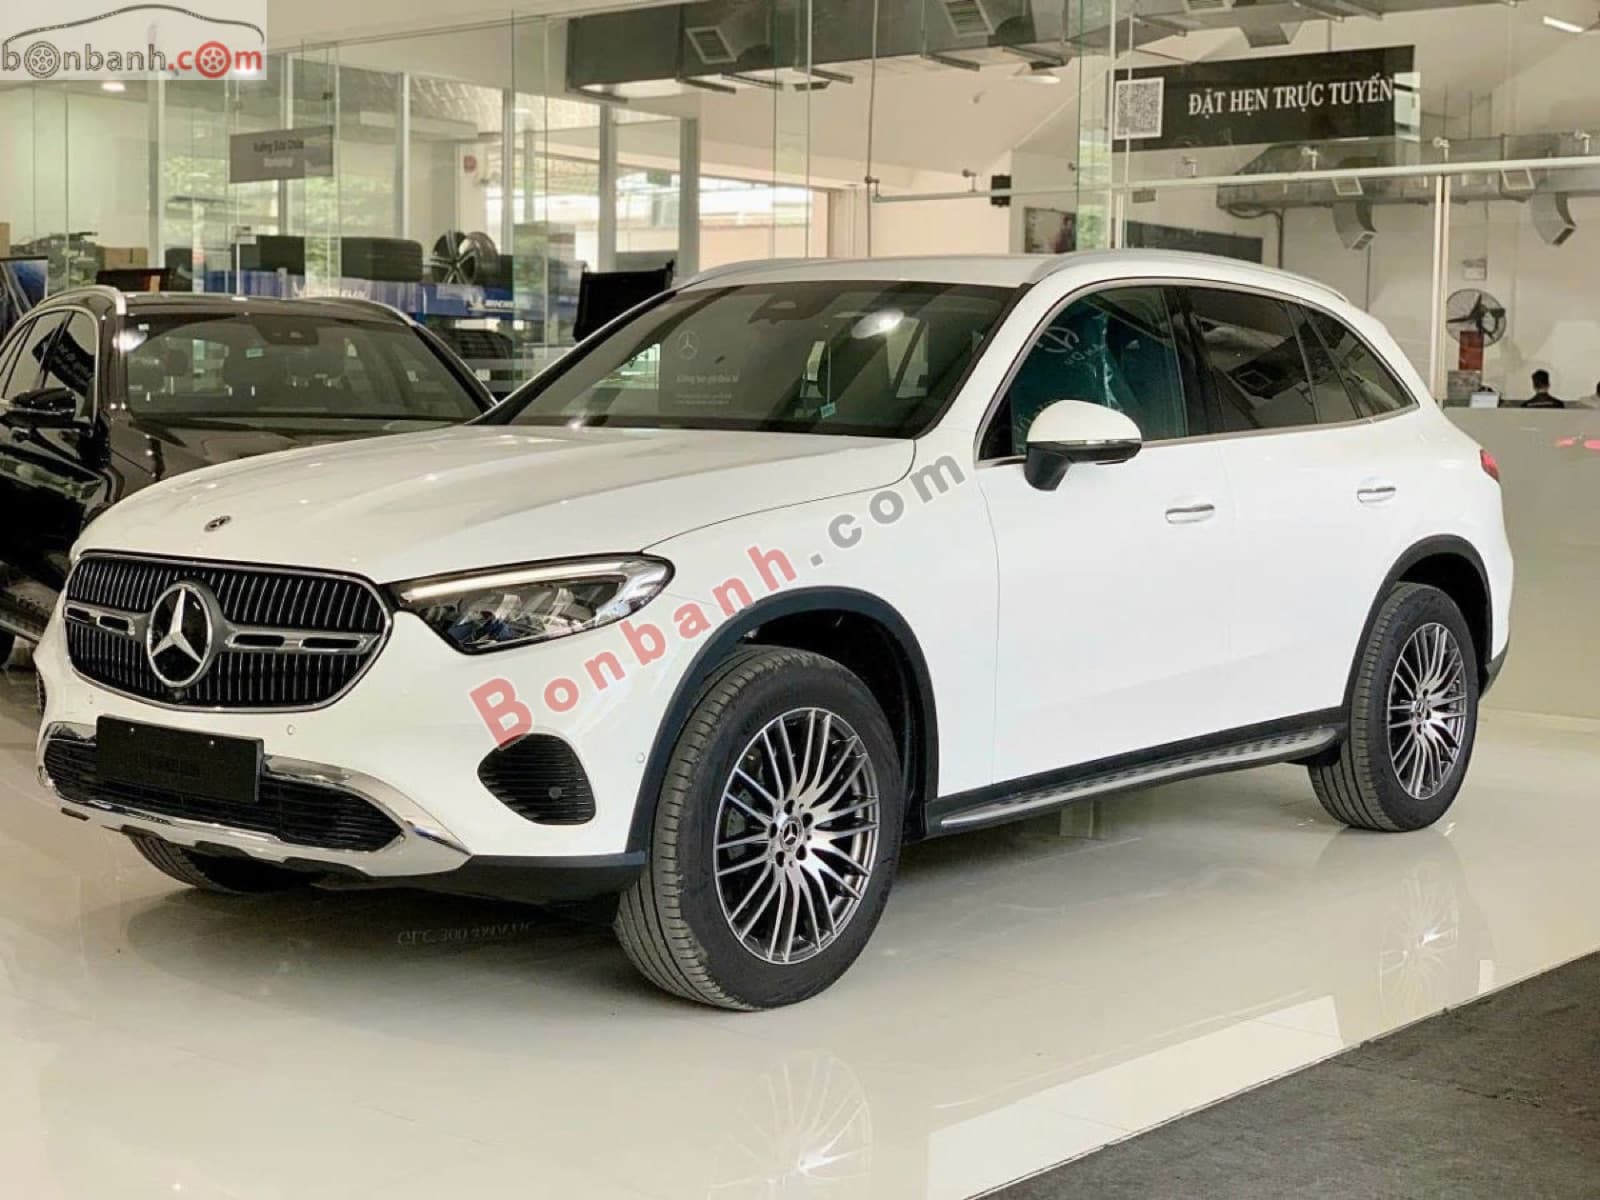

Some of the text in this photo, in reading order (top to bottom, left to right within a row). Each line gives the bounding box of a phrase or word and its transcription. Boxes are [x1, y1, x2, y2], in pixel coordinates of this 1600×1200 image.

[1188, 72, 1393, 119] ĐẶT HẸN TRỰC TUYẾN
